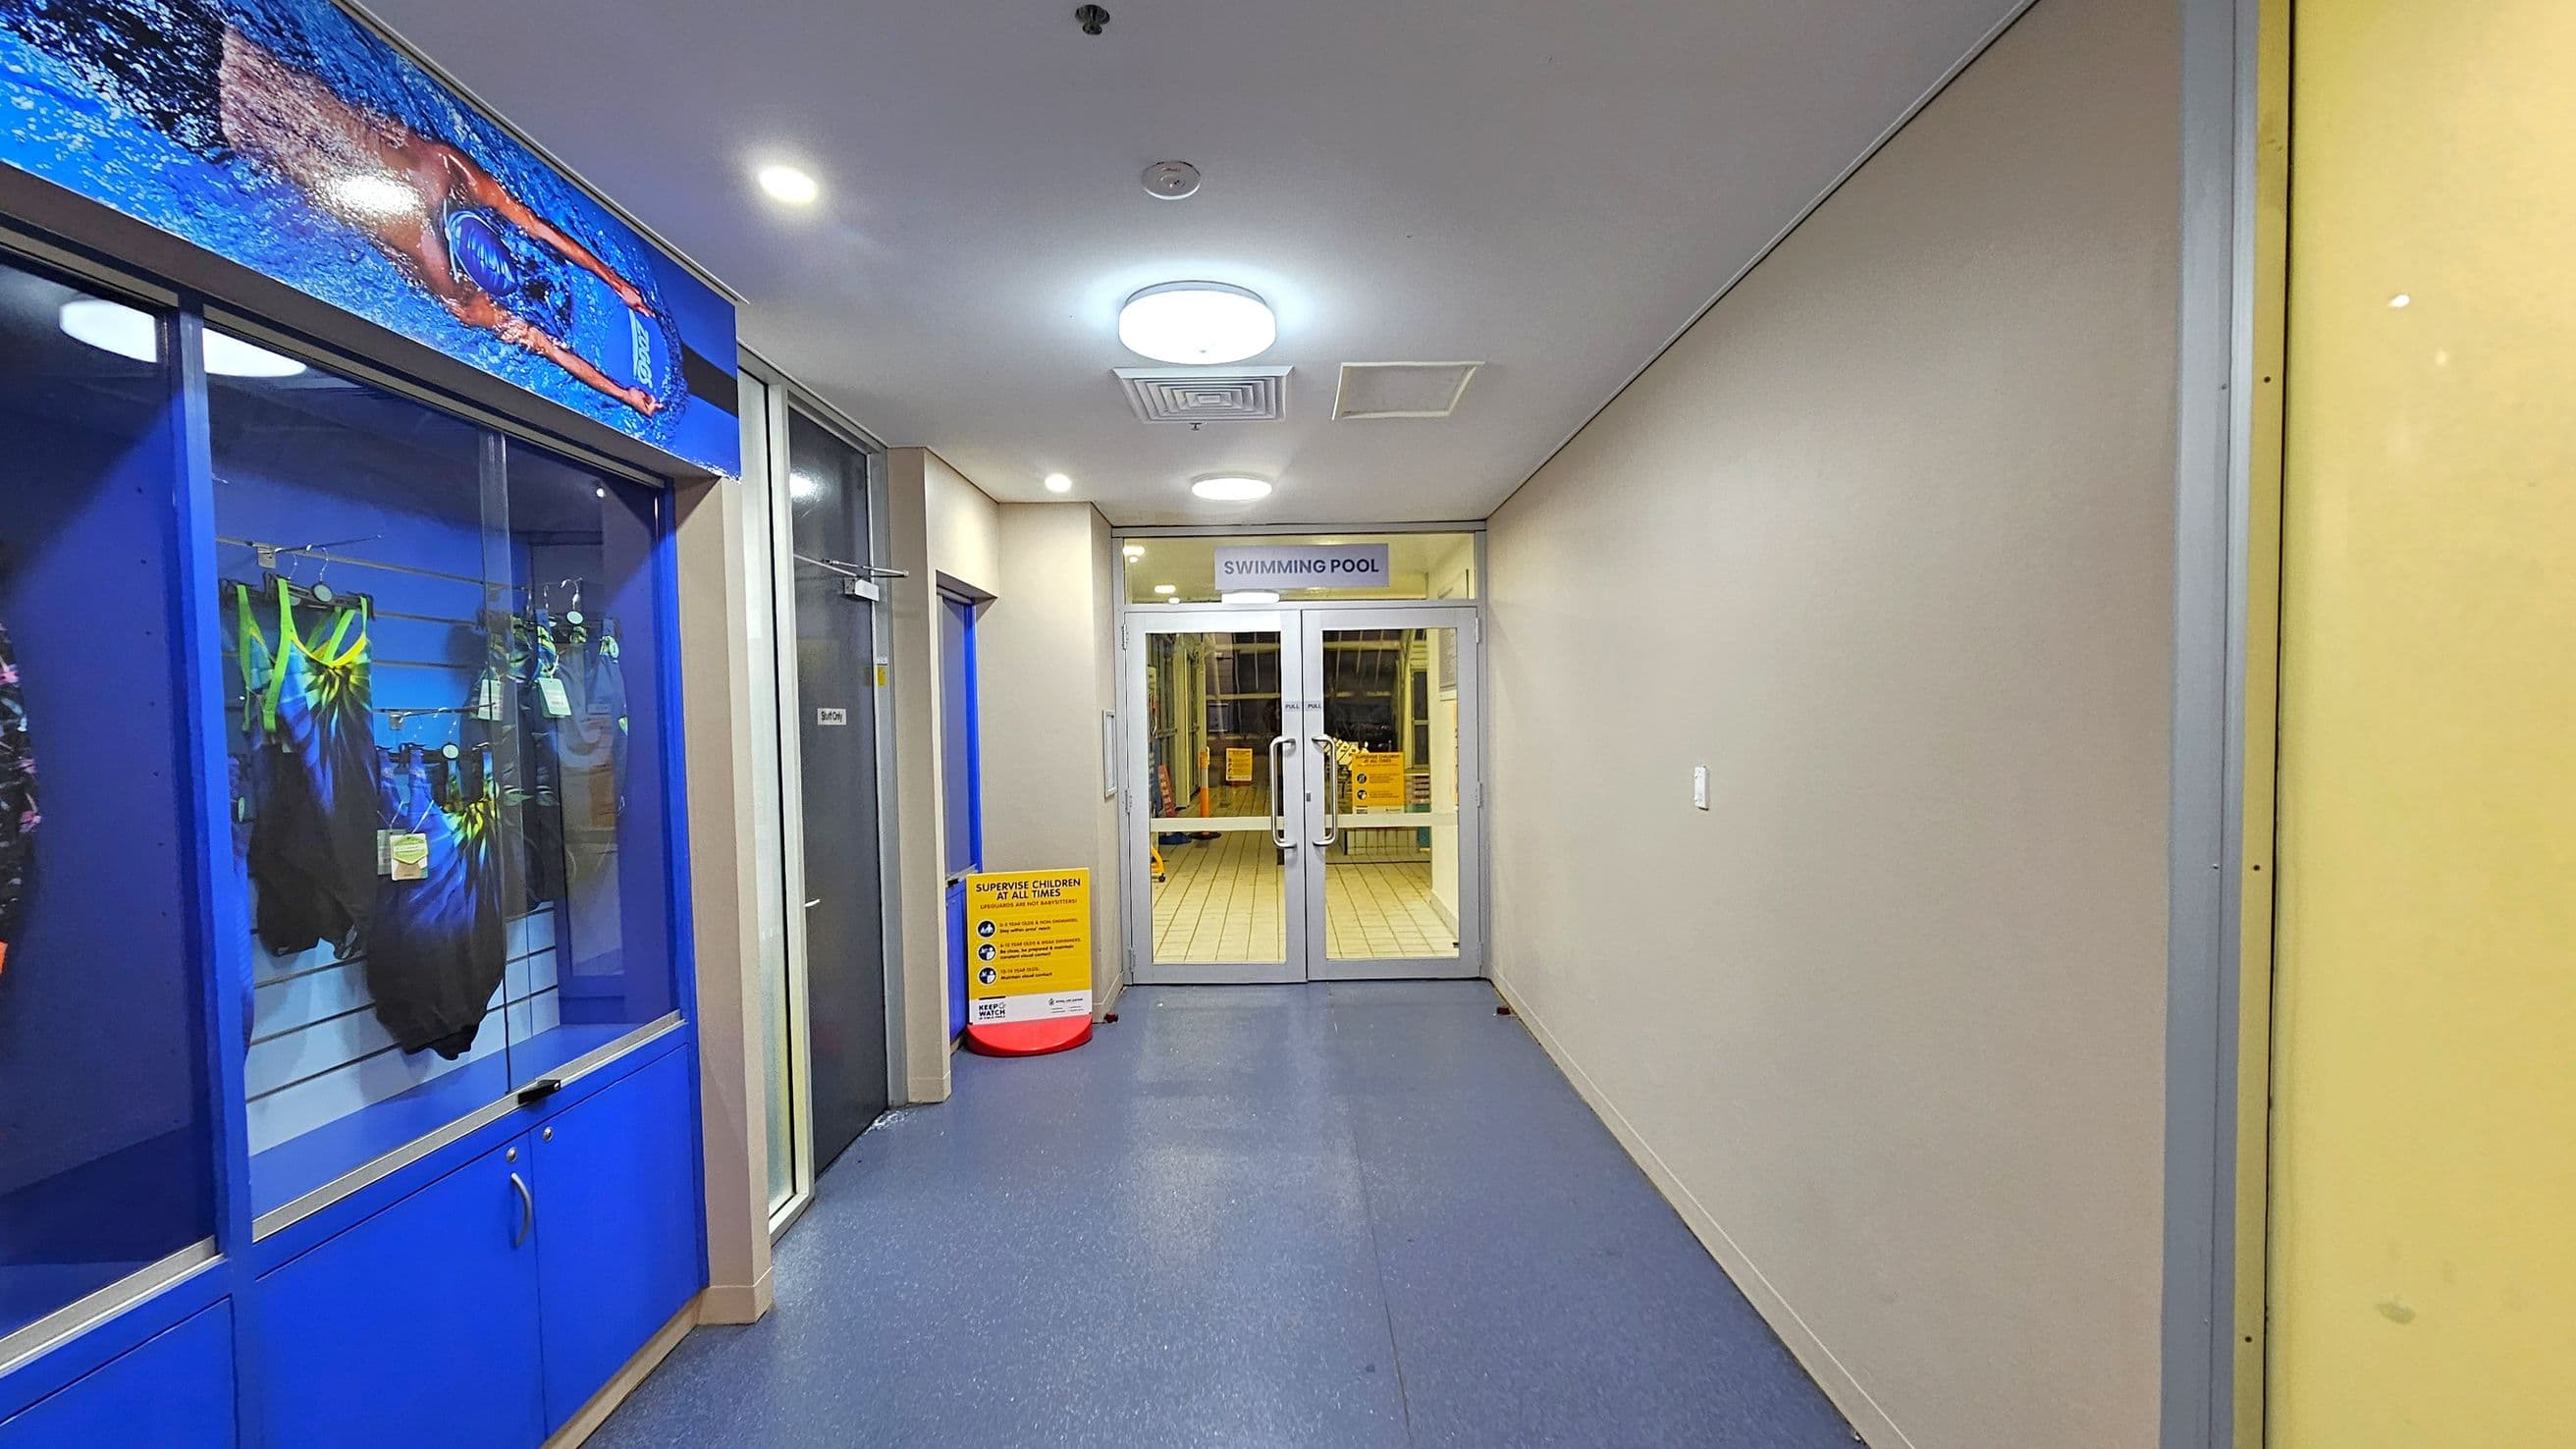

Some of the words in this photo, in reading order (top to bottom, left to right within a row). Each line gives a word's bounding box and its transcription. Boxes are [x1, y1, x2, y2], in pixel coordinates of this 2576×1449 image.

[1224, 560, 1325, 574] SWIMMING
[1330, 559, 1379, 572] POOL
[976, 881, 1029, 892] SUPERVISE
[1032, 879, 1081, 889] CHILDREN
[996, 891, 1008, 900] AT
[1011, 890, 1029, 899] ALL
[1032, 888, 1061, 898] TIMES
